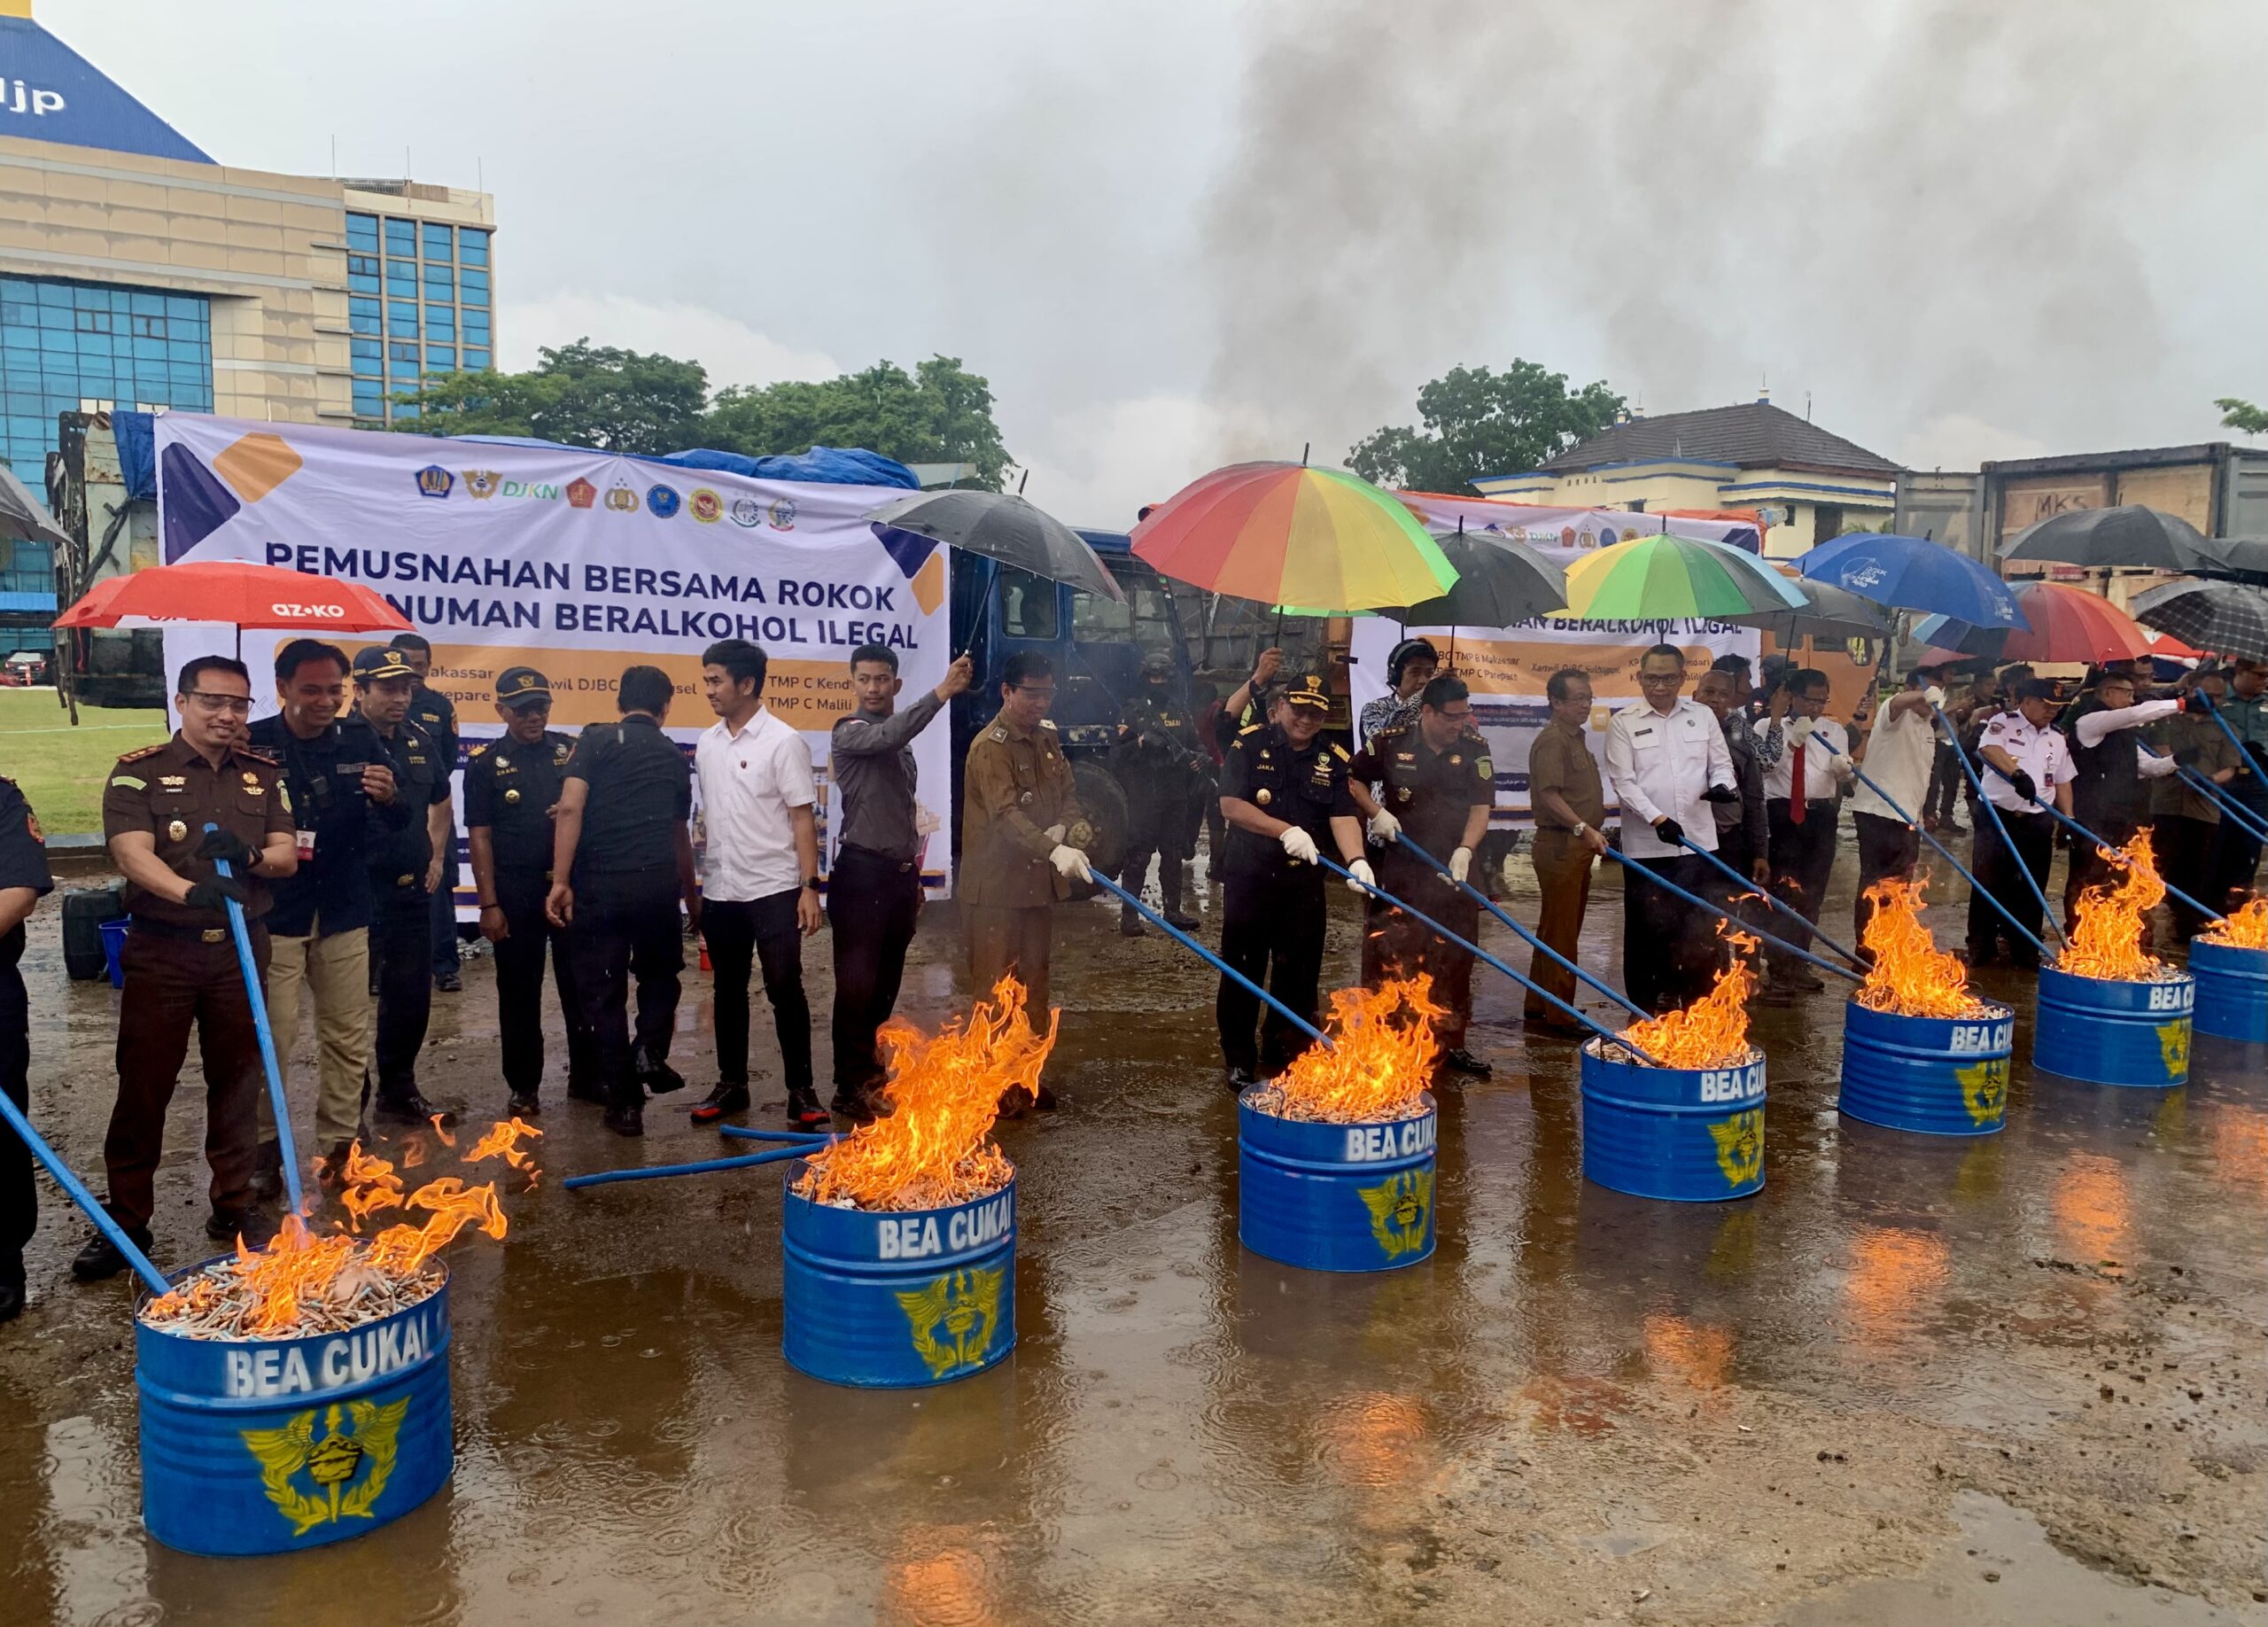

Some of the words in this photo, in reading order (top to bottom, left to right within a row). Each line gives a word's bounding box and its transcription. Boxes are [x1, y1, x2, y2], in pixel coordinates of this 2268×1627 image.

[266, 541, 570, 589] PEMUSNAHAN
[585, 564, 766, 603] BERSAMA
[778, 581, 895, 611] ROKOK
[555, 603, 807, 643] BERALKOHOL
[818, 619, 919, 650] ILEGAL
[427, 666, 494, 679] akassar
[578, 678, 618, 690] DJBC
[768, 676, 799, 688] TMP
[804, 677, 812, 689] C
[817, 678, 851, 689] Kend
[767, 697, 799, 709] TMP
[804, 697, 812, 709] C
[817, 698, 852, 711] Malili
[2149, 986, 2181, 1009] BEA
[1949, 1026, 1990, 1051] BEA
[1701, 1070, 1744, 1102] BEA
[1347, 1126, 1397, 1162] BEA
[879, 1217, 943, 1259] BEA
[949, 1191, 1012, 1250] CUKAI
[227, 1347, 313, 1397] BEA
[322, 1309, 429, 1387] CUKAI
